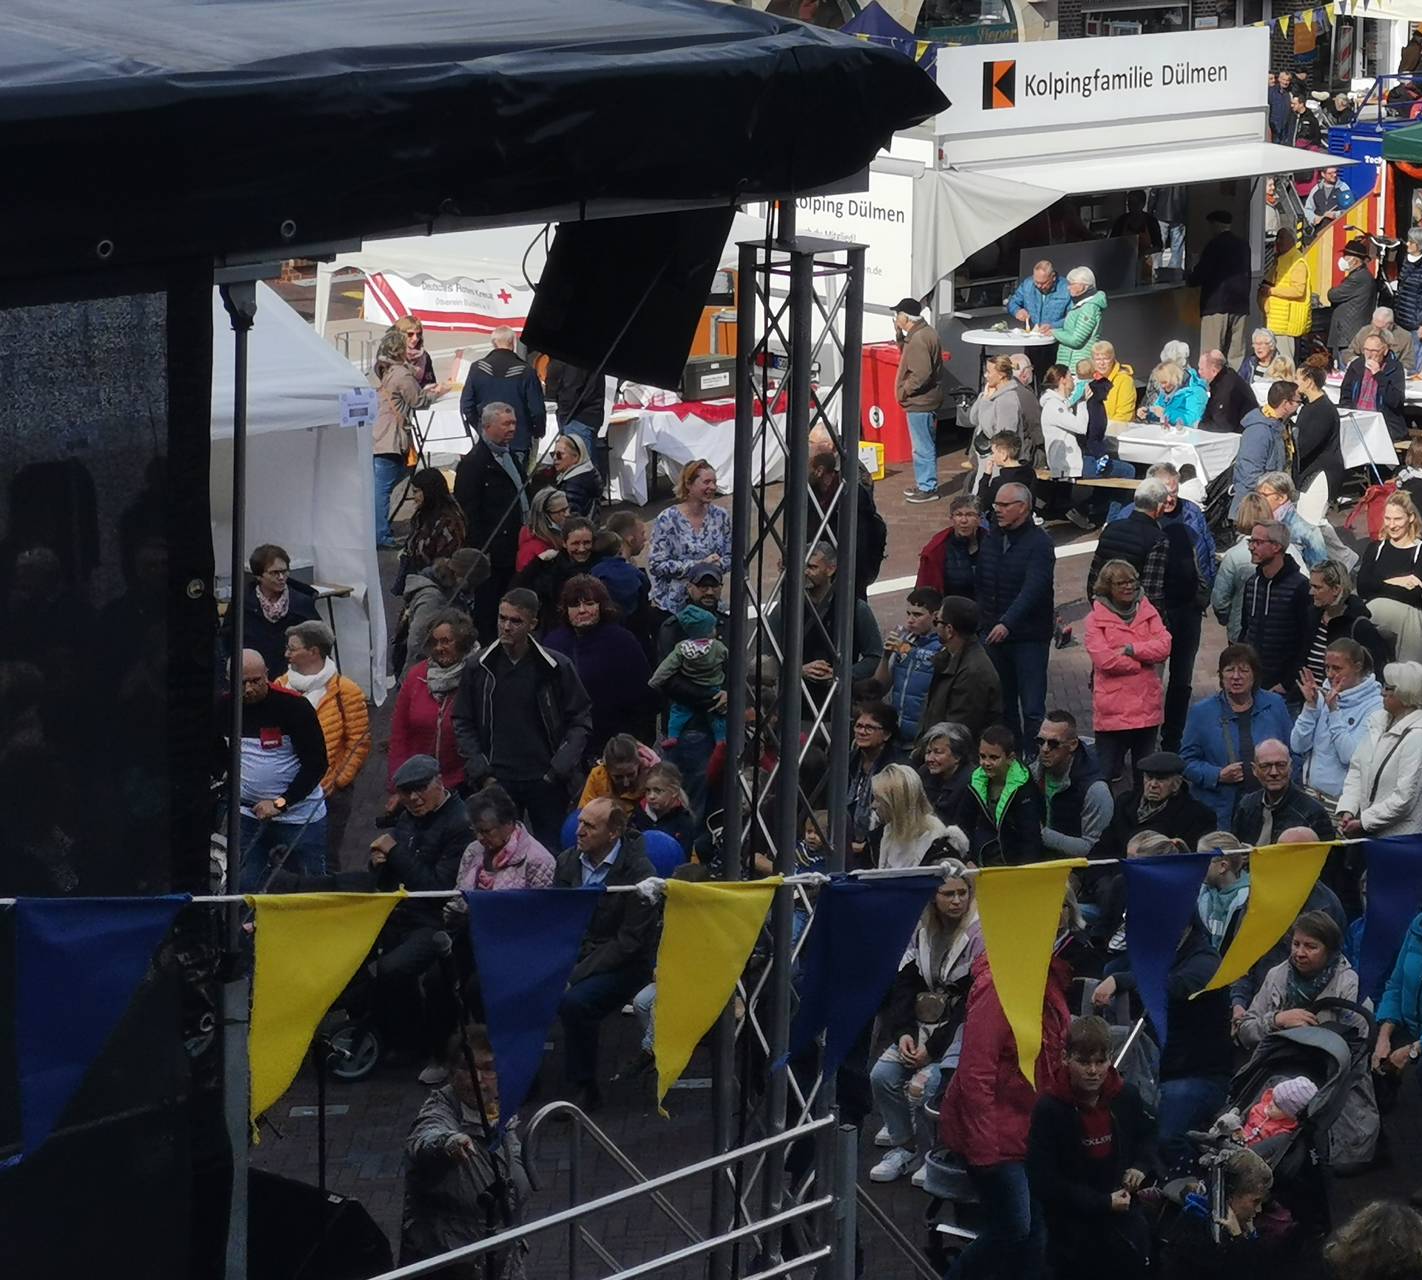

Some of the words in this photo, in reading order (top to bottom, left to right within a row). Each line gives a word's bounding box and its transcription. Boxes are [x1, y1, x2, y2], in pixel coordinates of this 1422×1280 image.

[1024, 65, 1154, 100] Kolpingfamilie
[1162, 61, 1228, 87] Dülmen
[795, 196, 844, 218] olping
[848, 199, 905, 224] Dülmen
